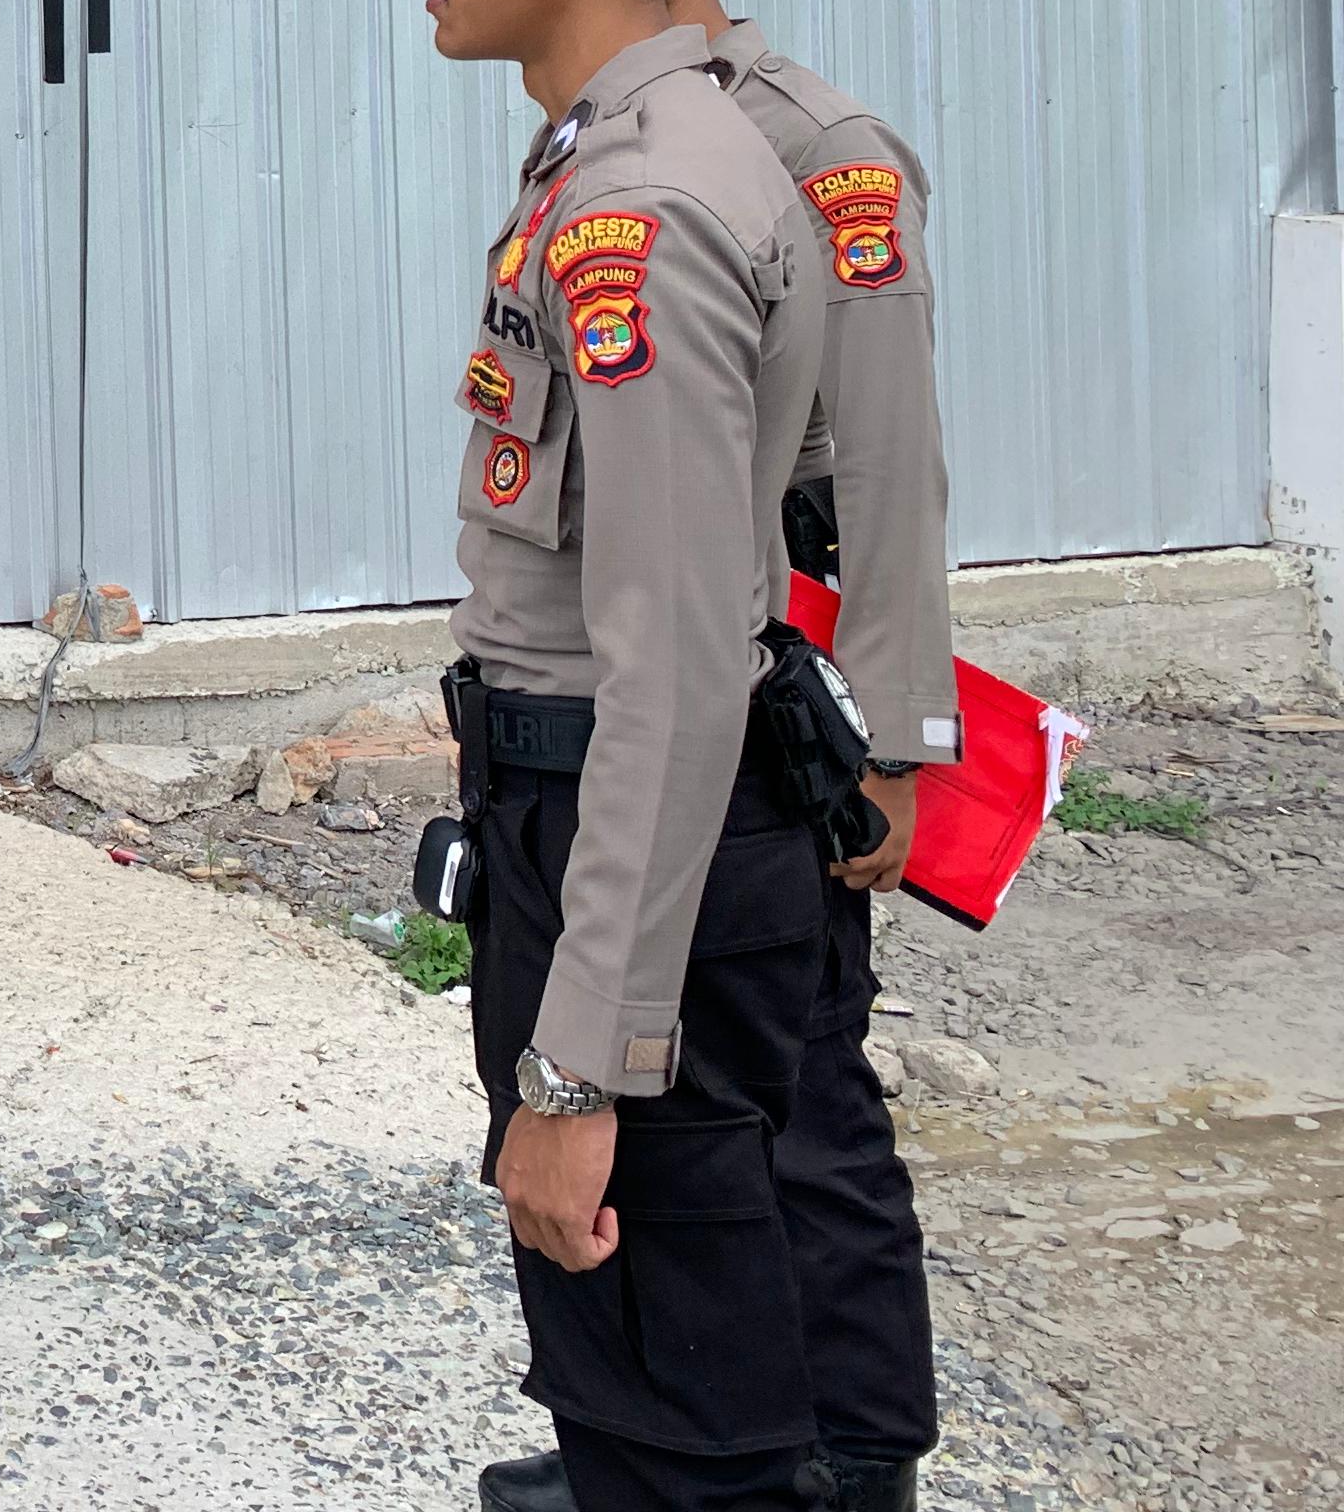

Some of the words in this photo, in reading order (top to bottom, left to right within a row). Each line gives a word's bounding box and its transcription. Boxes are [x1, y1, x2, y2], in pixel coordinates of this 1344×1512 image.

[813, 169, 897, 197] POLRESTA
[853, 182, 896, 195] LAMPUNG
[832, 203, 890, 219] LAMPUNG
[549, 217, 646, 264] POLRESTA
[588, 237, 643, 252] LAMPUNG
[569, 268, 636, 293] LAMPUNG
